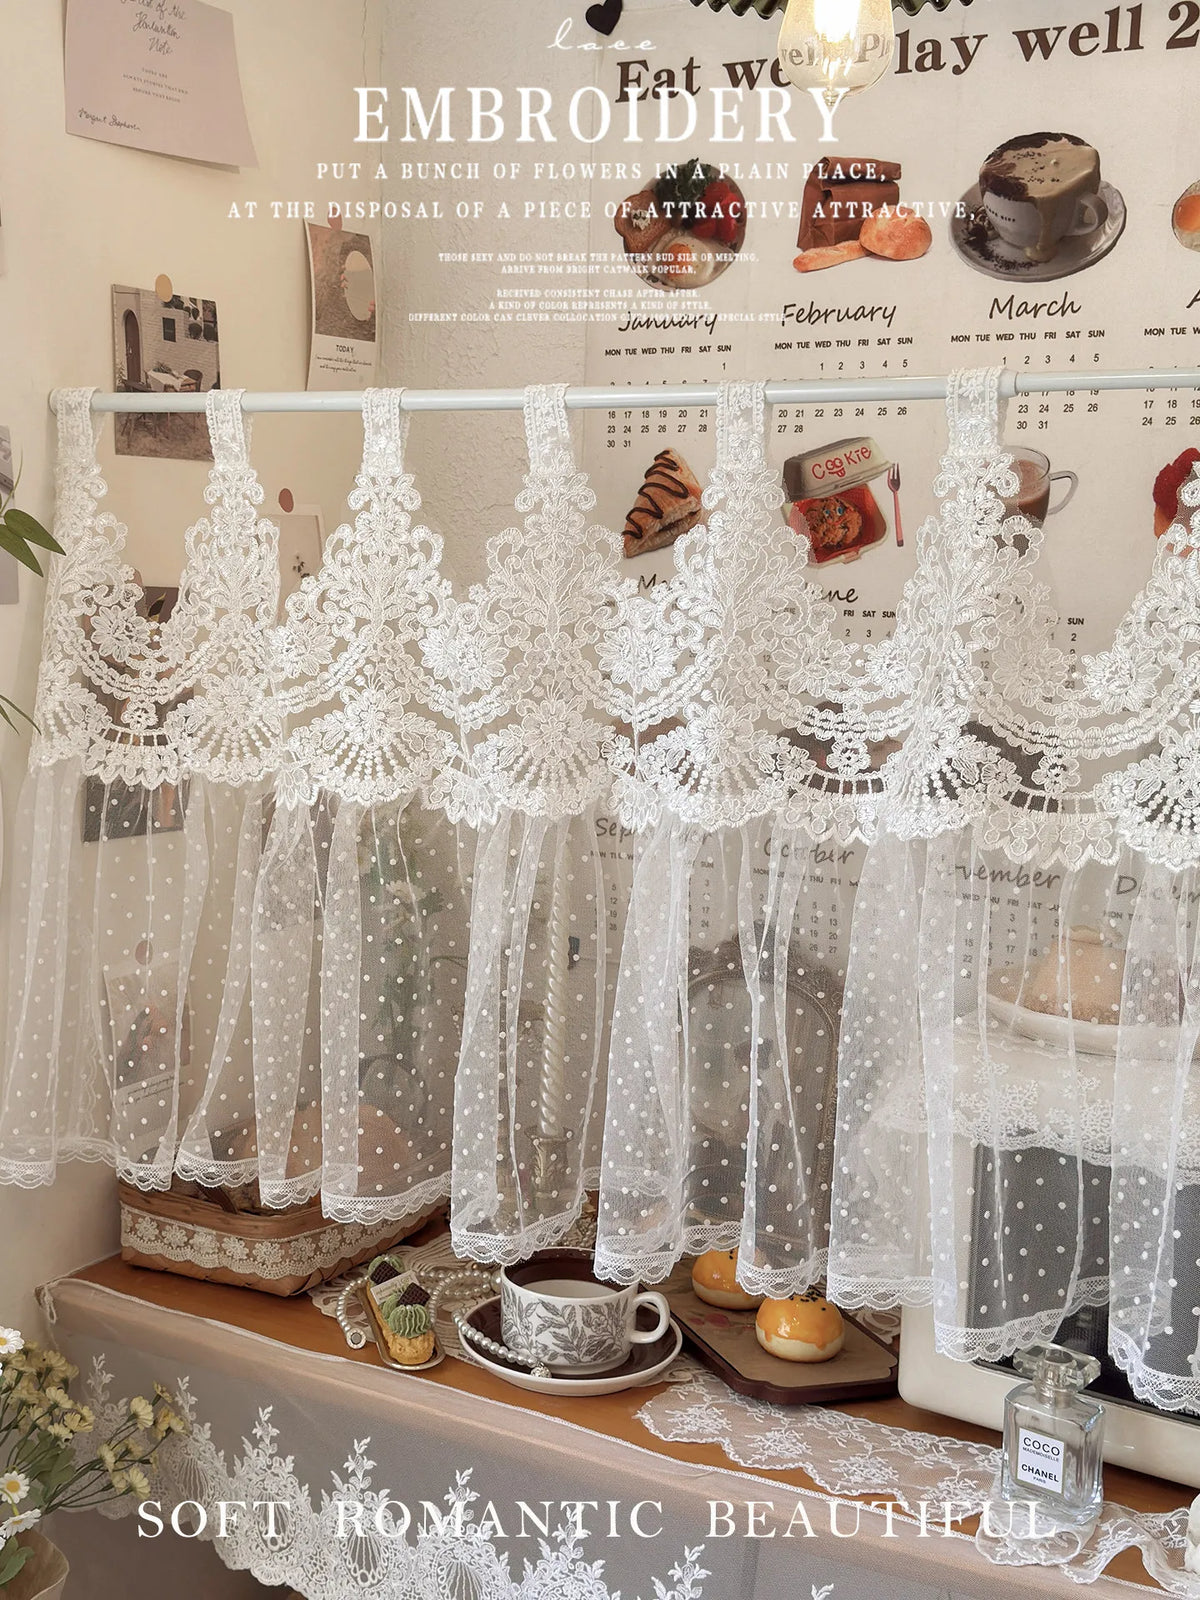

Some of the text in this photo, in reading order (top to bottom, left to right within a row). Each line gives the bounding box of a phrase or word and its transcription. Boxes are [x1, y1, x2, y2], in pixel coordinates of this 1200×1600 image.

[615, 56, 702, 103] Eat
[1012, 2, 1145, 62] well
[989, 291, 1082, 320] March
[781, 301, 897, 328] February
[996, 333, 1015, 341] WED
[1088, 330, 1105, 338] SUN
[1144, 328, 1165, 336] MON
[1170, 327, 1187, 335] TUE
[774, 342, 792, 350] MON
[796, 341, 810, 349] TUE
[815, 340, 831, 348] WED
[836, 339, 851, 347] THU
[857, 338, 869, 346] FRI
[897, 337, 913, 345] SUN
[336, 344, 354, 353] TODAY
[641, 347, 657, 355] WED
[661, 346, 675, 354] THU
[699, 345, 711, 353] SAT
[1018, 404, 1098, 413] 23 24 25 26
[1143, 400, 1177, 409] 17 18
[608, 409, 708, 419] 16 18 19 20 21
[778, 407, 907, 418] 20 21 22 23 24 25 26
[1016, 421, 1048, 429] 30 31
[1142, 416, 1176, 426] 24 25
[777, 424, 803, 433] 27 28
[607, 440, 631, 448] 30 31
[843, 609, 855, 617] FRI
[862, 610, 876, 618] SAT
[1067, 617, 1085, 625] SUN
[845, 628, 872, 638] 2 3
[1071, 632, 1077, 641] 2
[1064, 680, 1075, 689] 23
[829, 932, 838, 940] 20
[1023, 1437, 1060, 1456] COCO
[1021, 1463, 1059, 1483] CHANEL
